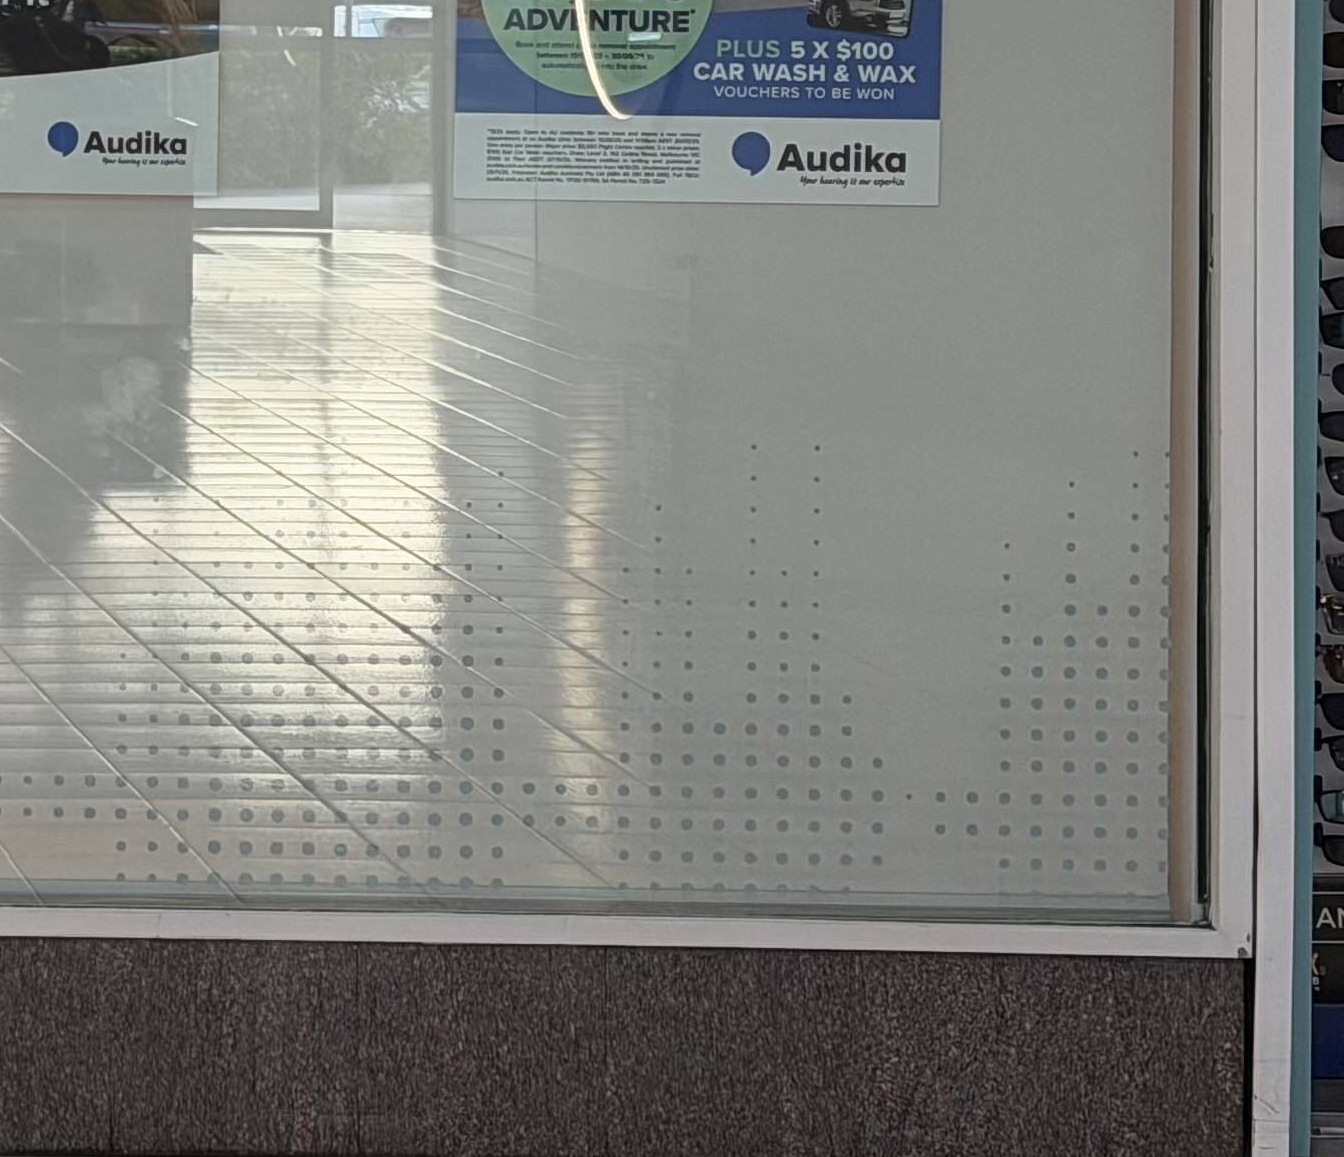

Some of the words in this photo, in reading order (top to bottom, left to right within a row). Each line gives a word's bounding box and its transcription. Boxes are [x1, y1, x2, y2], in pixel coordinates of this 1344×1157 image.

[717, 39, 780, 58] PLUS
[790, 40, 806, 59] 5
[812, 41, 830, 59] X
[836, 39, 894, 61] $100
[693, 62, 744, 81] CAR
[752, 63, 826, 82] WASH
[833, 64, 850, 82] &
[858, 65, 916, 83] WAX
[713, 85, 800, 99] VOUCHERS
[805, 87, 826, 99] TO
[832, 88, 851, 100] BE
[857, 88, 895, 100] WON
[83, 130, 187, 155] Audika
[776, 142, 906, 173] Audika
